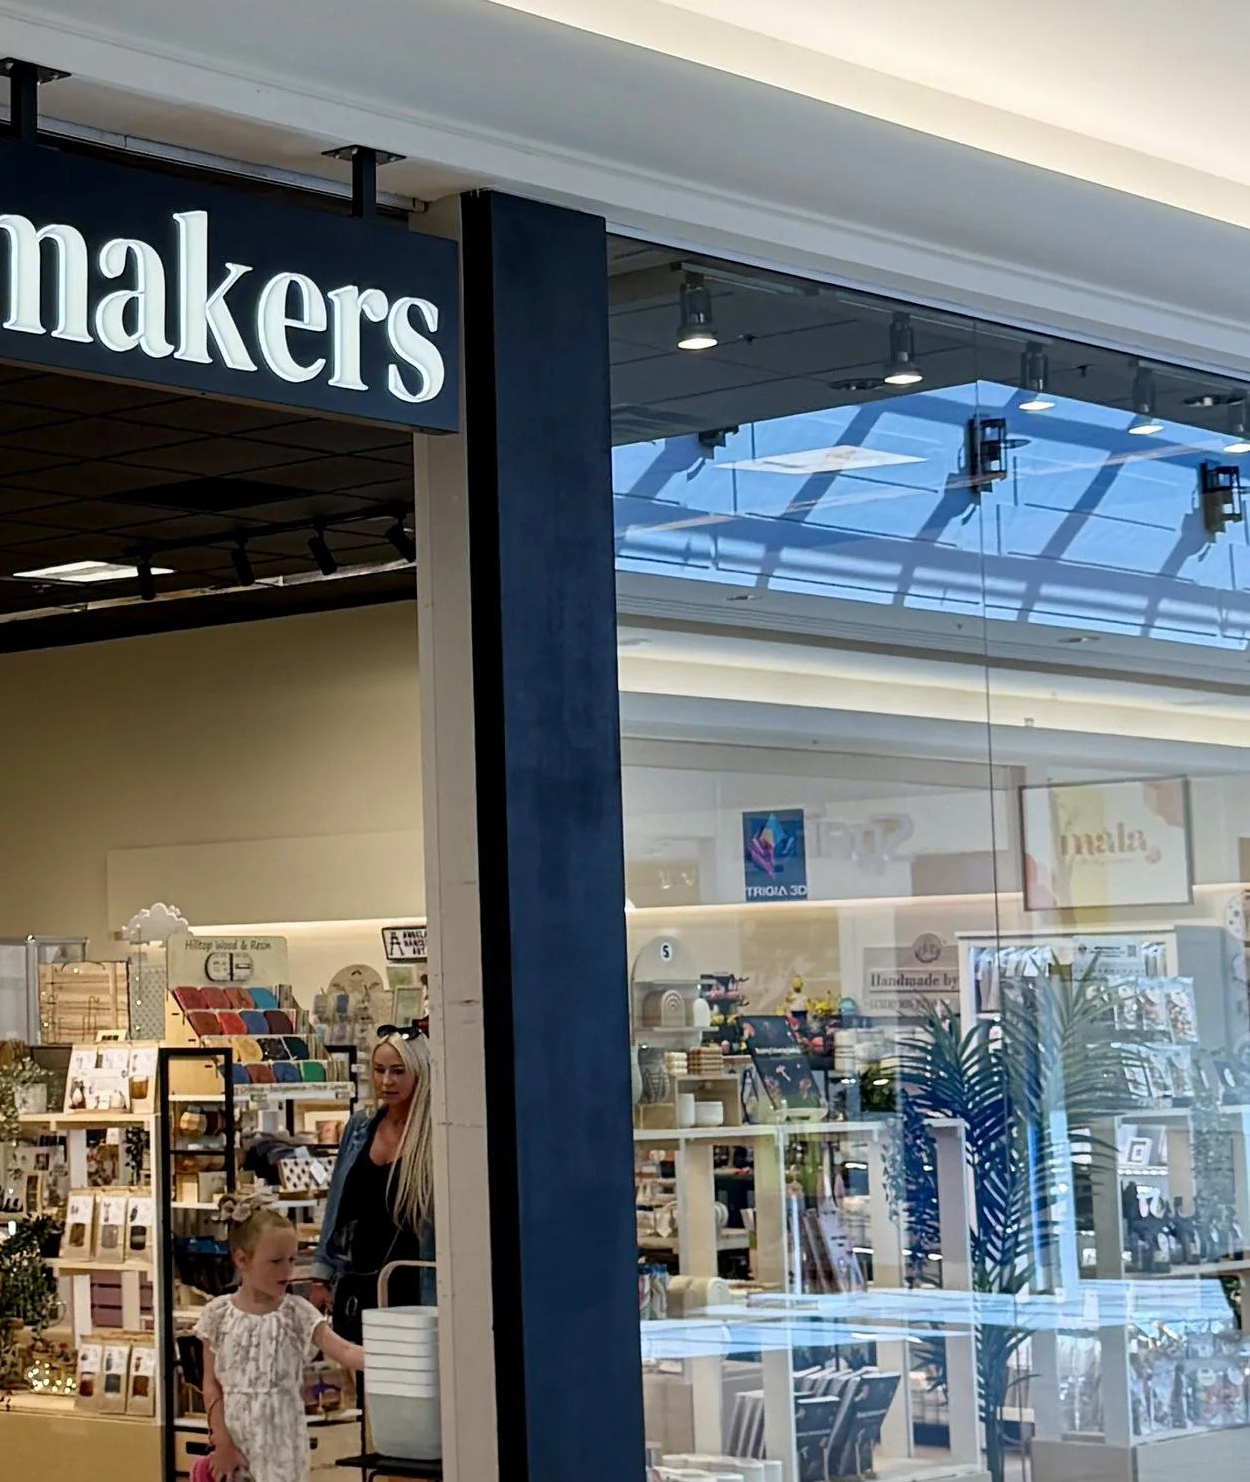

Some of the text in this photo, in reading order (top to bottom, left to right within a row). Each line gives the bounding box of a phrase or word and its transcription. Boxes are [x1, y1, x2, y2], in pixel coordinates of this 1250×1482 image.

[789, 884, 808, 896] 3D
[214, 939, 237, 951] Wood
[250, 940, 272, 950] Resin
[870, 972, 959, 991] Handmade by
